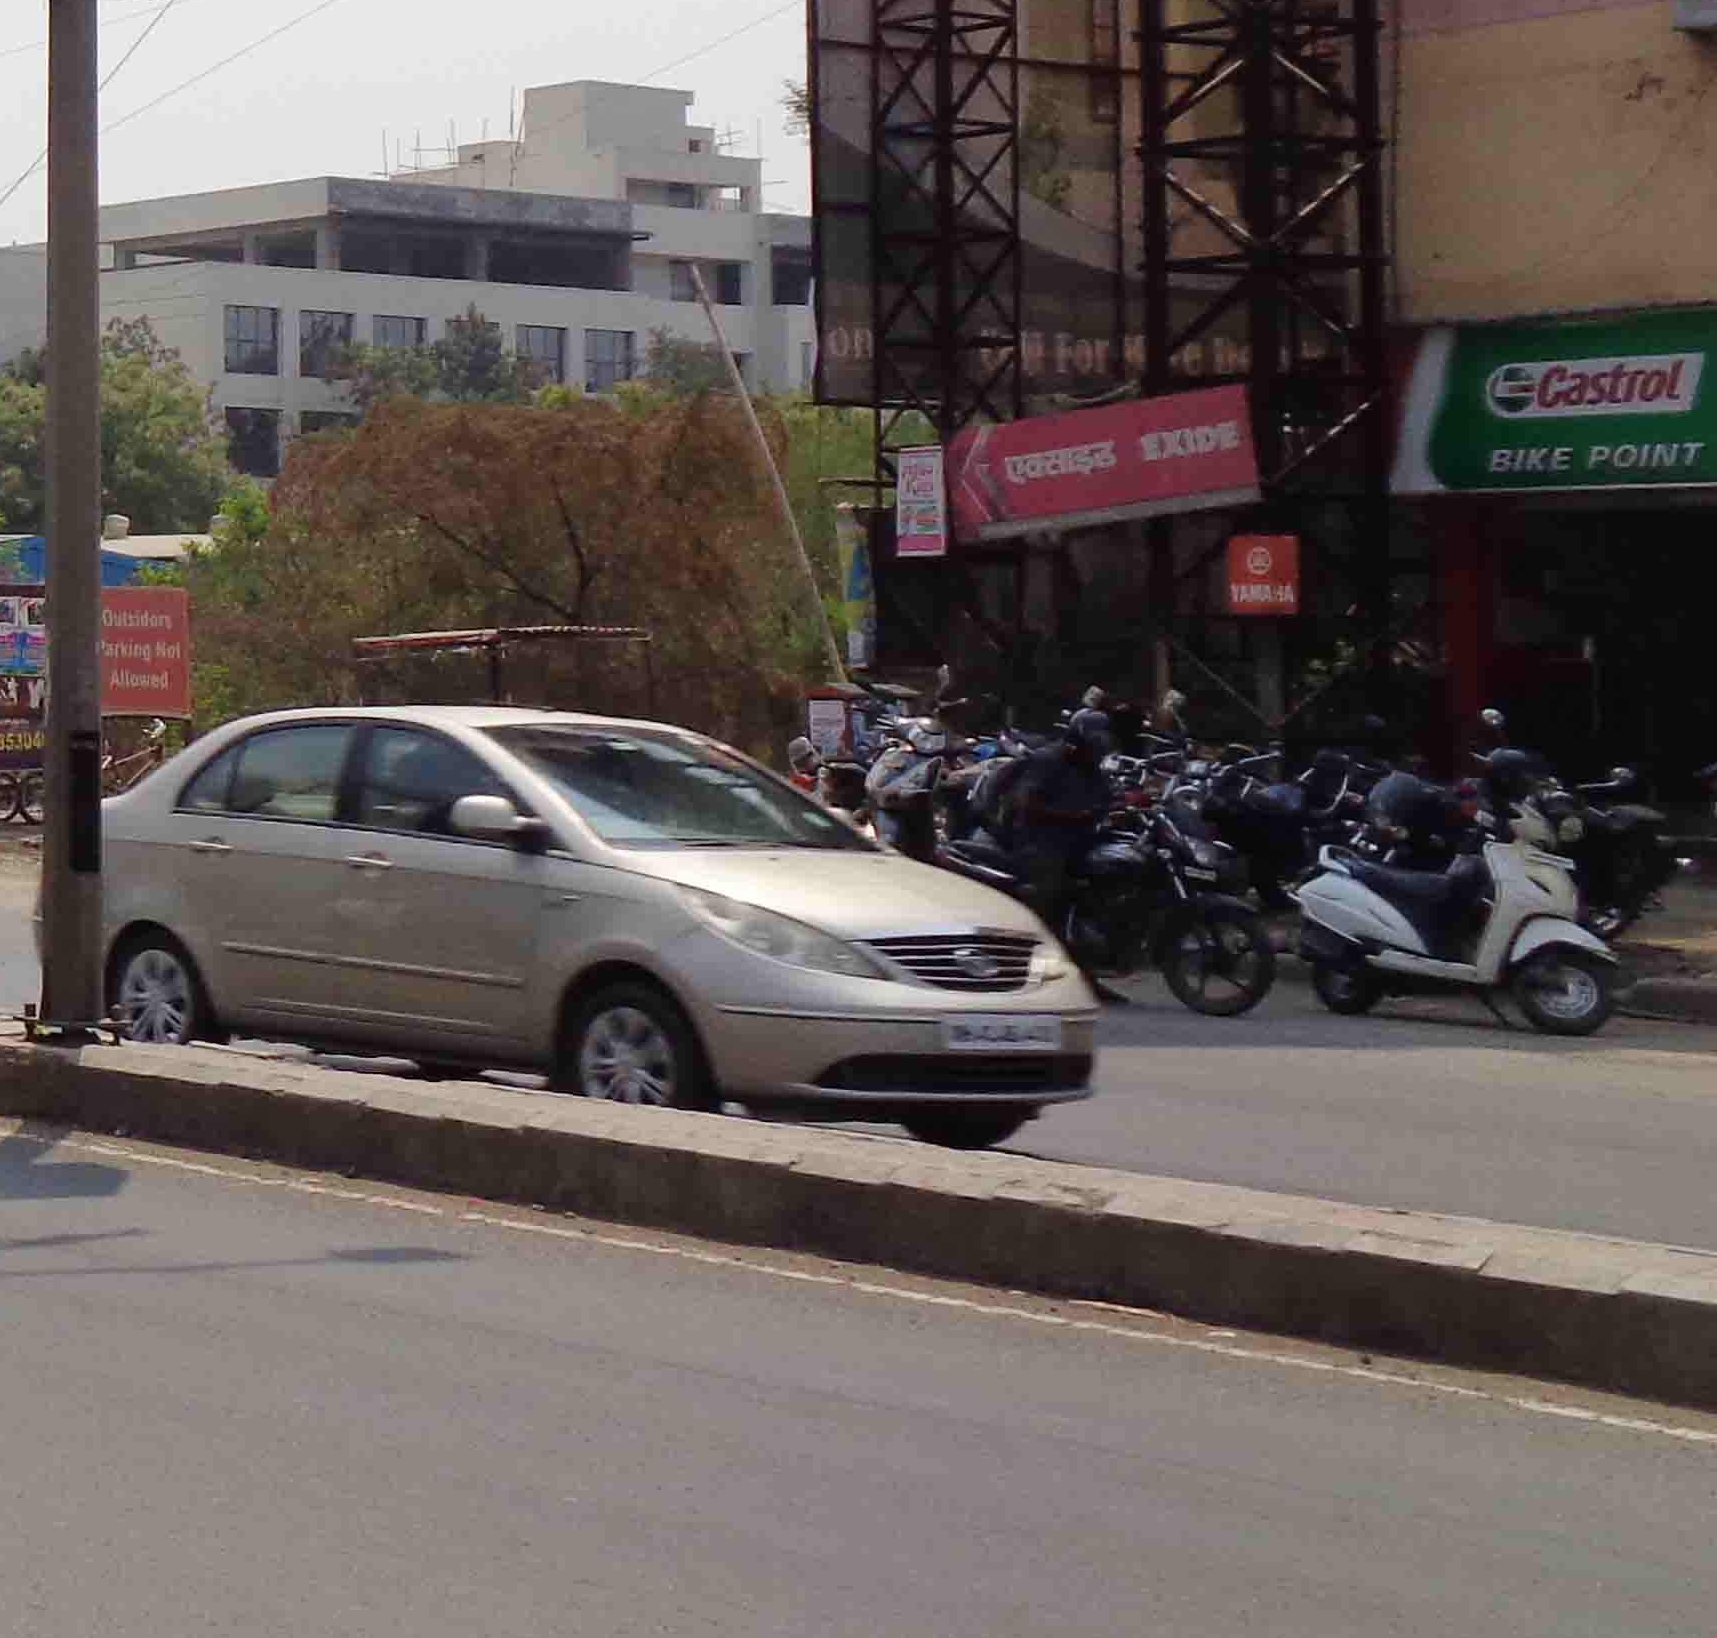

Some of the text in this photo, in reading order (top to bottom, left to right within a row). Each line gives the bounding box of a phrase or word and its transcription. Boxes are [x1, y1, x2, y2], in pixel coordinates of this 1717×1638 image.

[1537, 359, 1685, 409] Castrol
[1141, 420, 1238, 461] EXIDE
[1488, 441, 1705, 473] BIKE POINT
[1229, 583, 1294, 603] YAMAHA
[109, 669, 170, 692] Allowed
